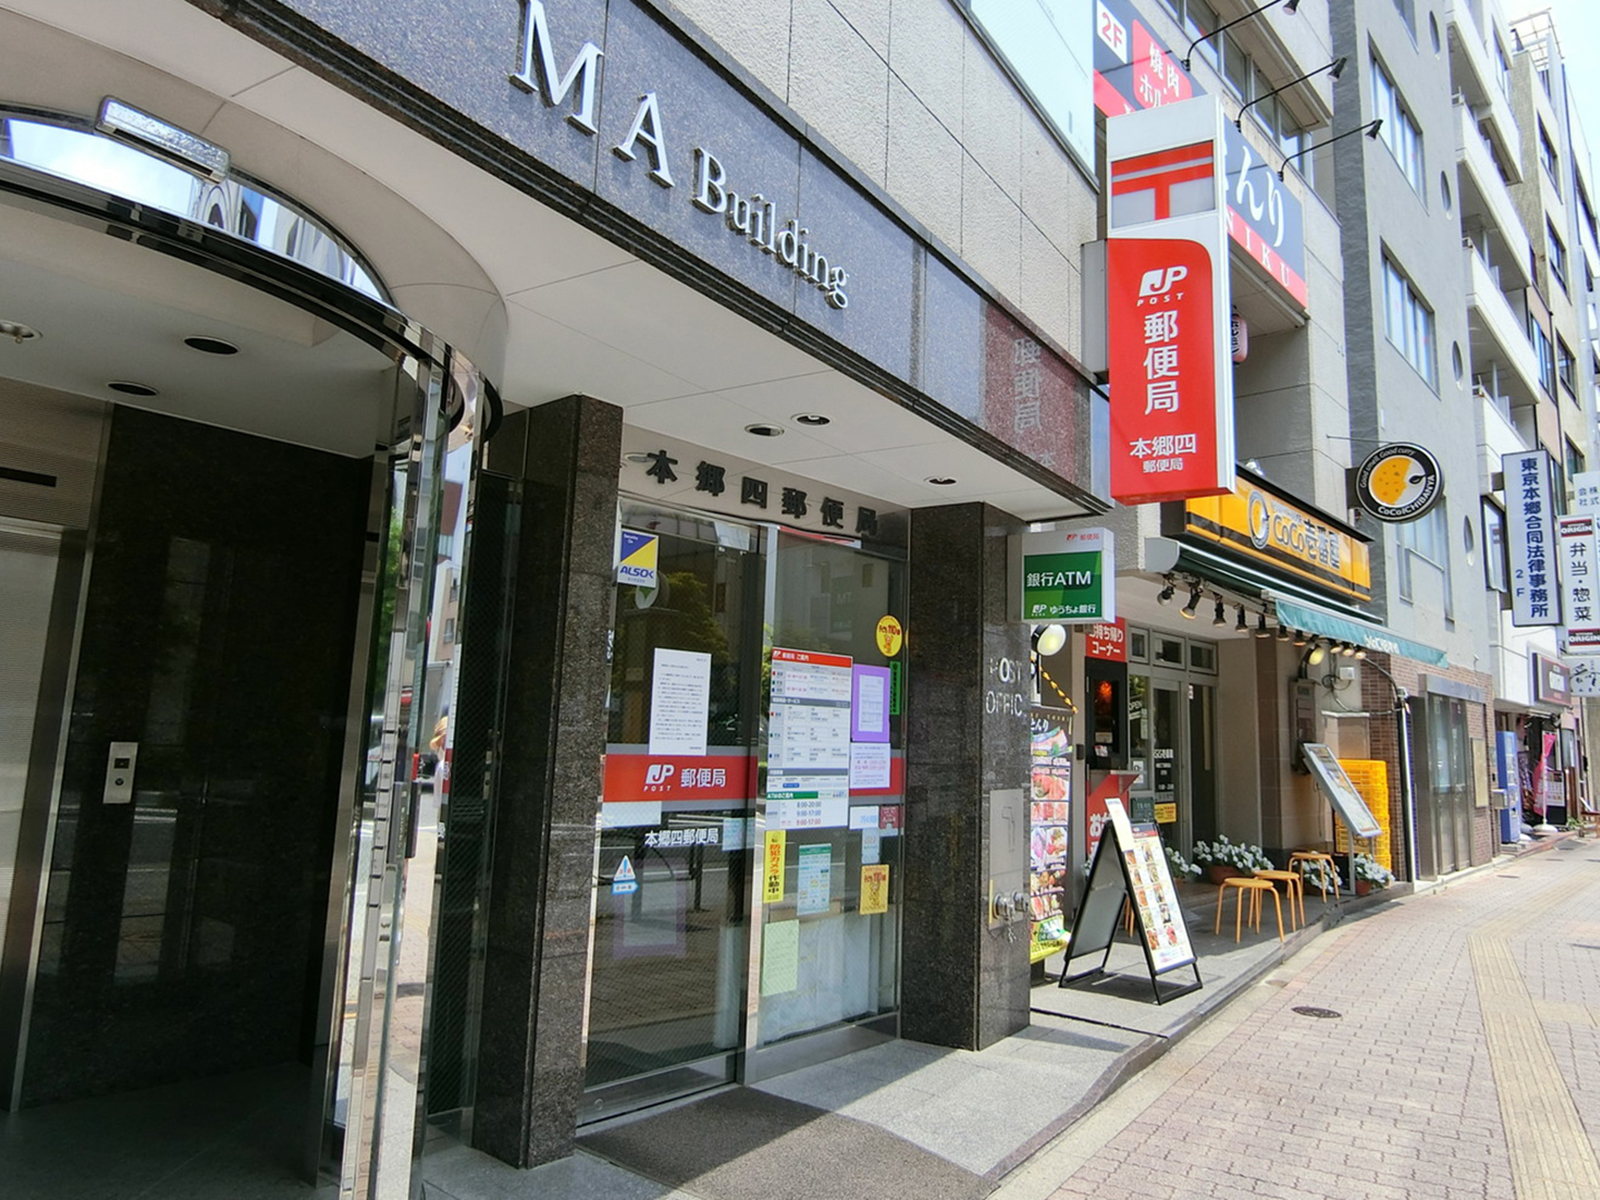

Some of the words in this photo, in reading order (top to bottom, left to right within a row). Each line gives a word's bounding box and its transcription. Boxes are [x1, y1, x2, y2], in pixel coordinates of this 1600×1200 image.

[1100, 11, 1125, 52] 2F
[1225, 140, 1286, 247] んり
[691, 147, 849, 309] Building
[1137, 292, 1185, 306] POST
[1144, 310, 1180, 415] 郵便局
[1129, 433, 1197, 459] 本郷四
[1142, 457, 1184, 474] 郵便局
[646, 449, 878, 537] 本郷四郵便局
[1520, 457, 1549, 619] 東京本郷合同法律事務所
[1560, 525, 1593, 535] ORIGIN
[620, 565, 655, 580] ALSOK
[1026, 570, 1092, 588] 銀行ATM
[1569, 541, 1593, 622] 弁当・惣菜
[1049, 603, 1097, 616] ゆうちょ銀行
[1091, 640, 1121, 657] コーナー
[680, 767, 726, 788] 郵便局
[643, 784, 672, 793] POST
[643, 827, 719, 848] 本郷四郵便局
